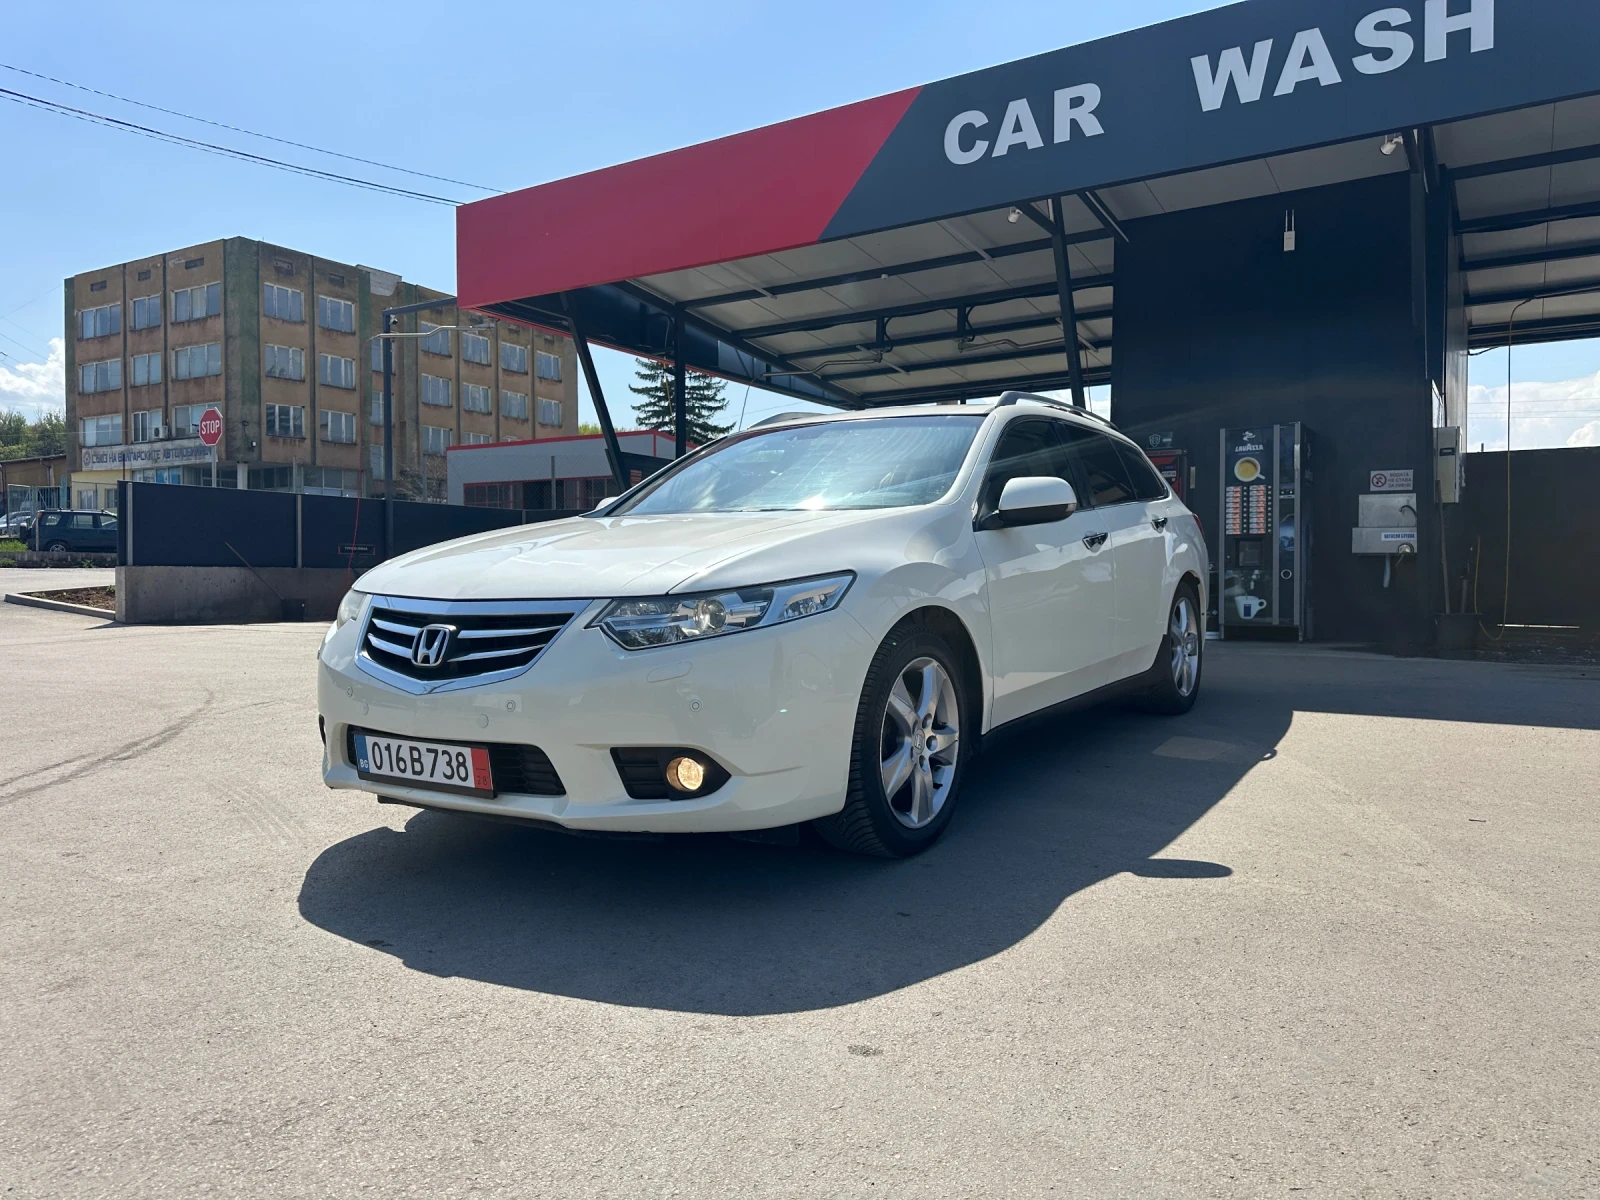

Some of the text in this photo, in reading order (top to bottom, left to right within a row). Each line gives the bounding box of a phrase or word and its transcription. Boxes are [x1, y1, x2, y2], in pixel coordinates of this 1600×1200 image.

[942, 0, 1496, 166] CAR WASH
[201, 420, 220, 435] STOP
[1234, 443, 1264, 453] LAVAZZA
[109, 452, 117, 463] НА
[359, 758, 369, 769] BG
[371, 741, 469, 783] 016B738
[477, 775, 487, 786] 28
